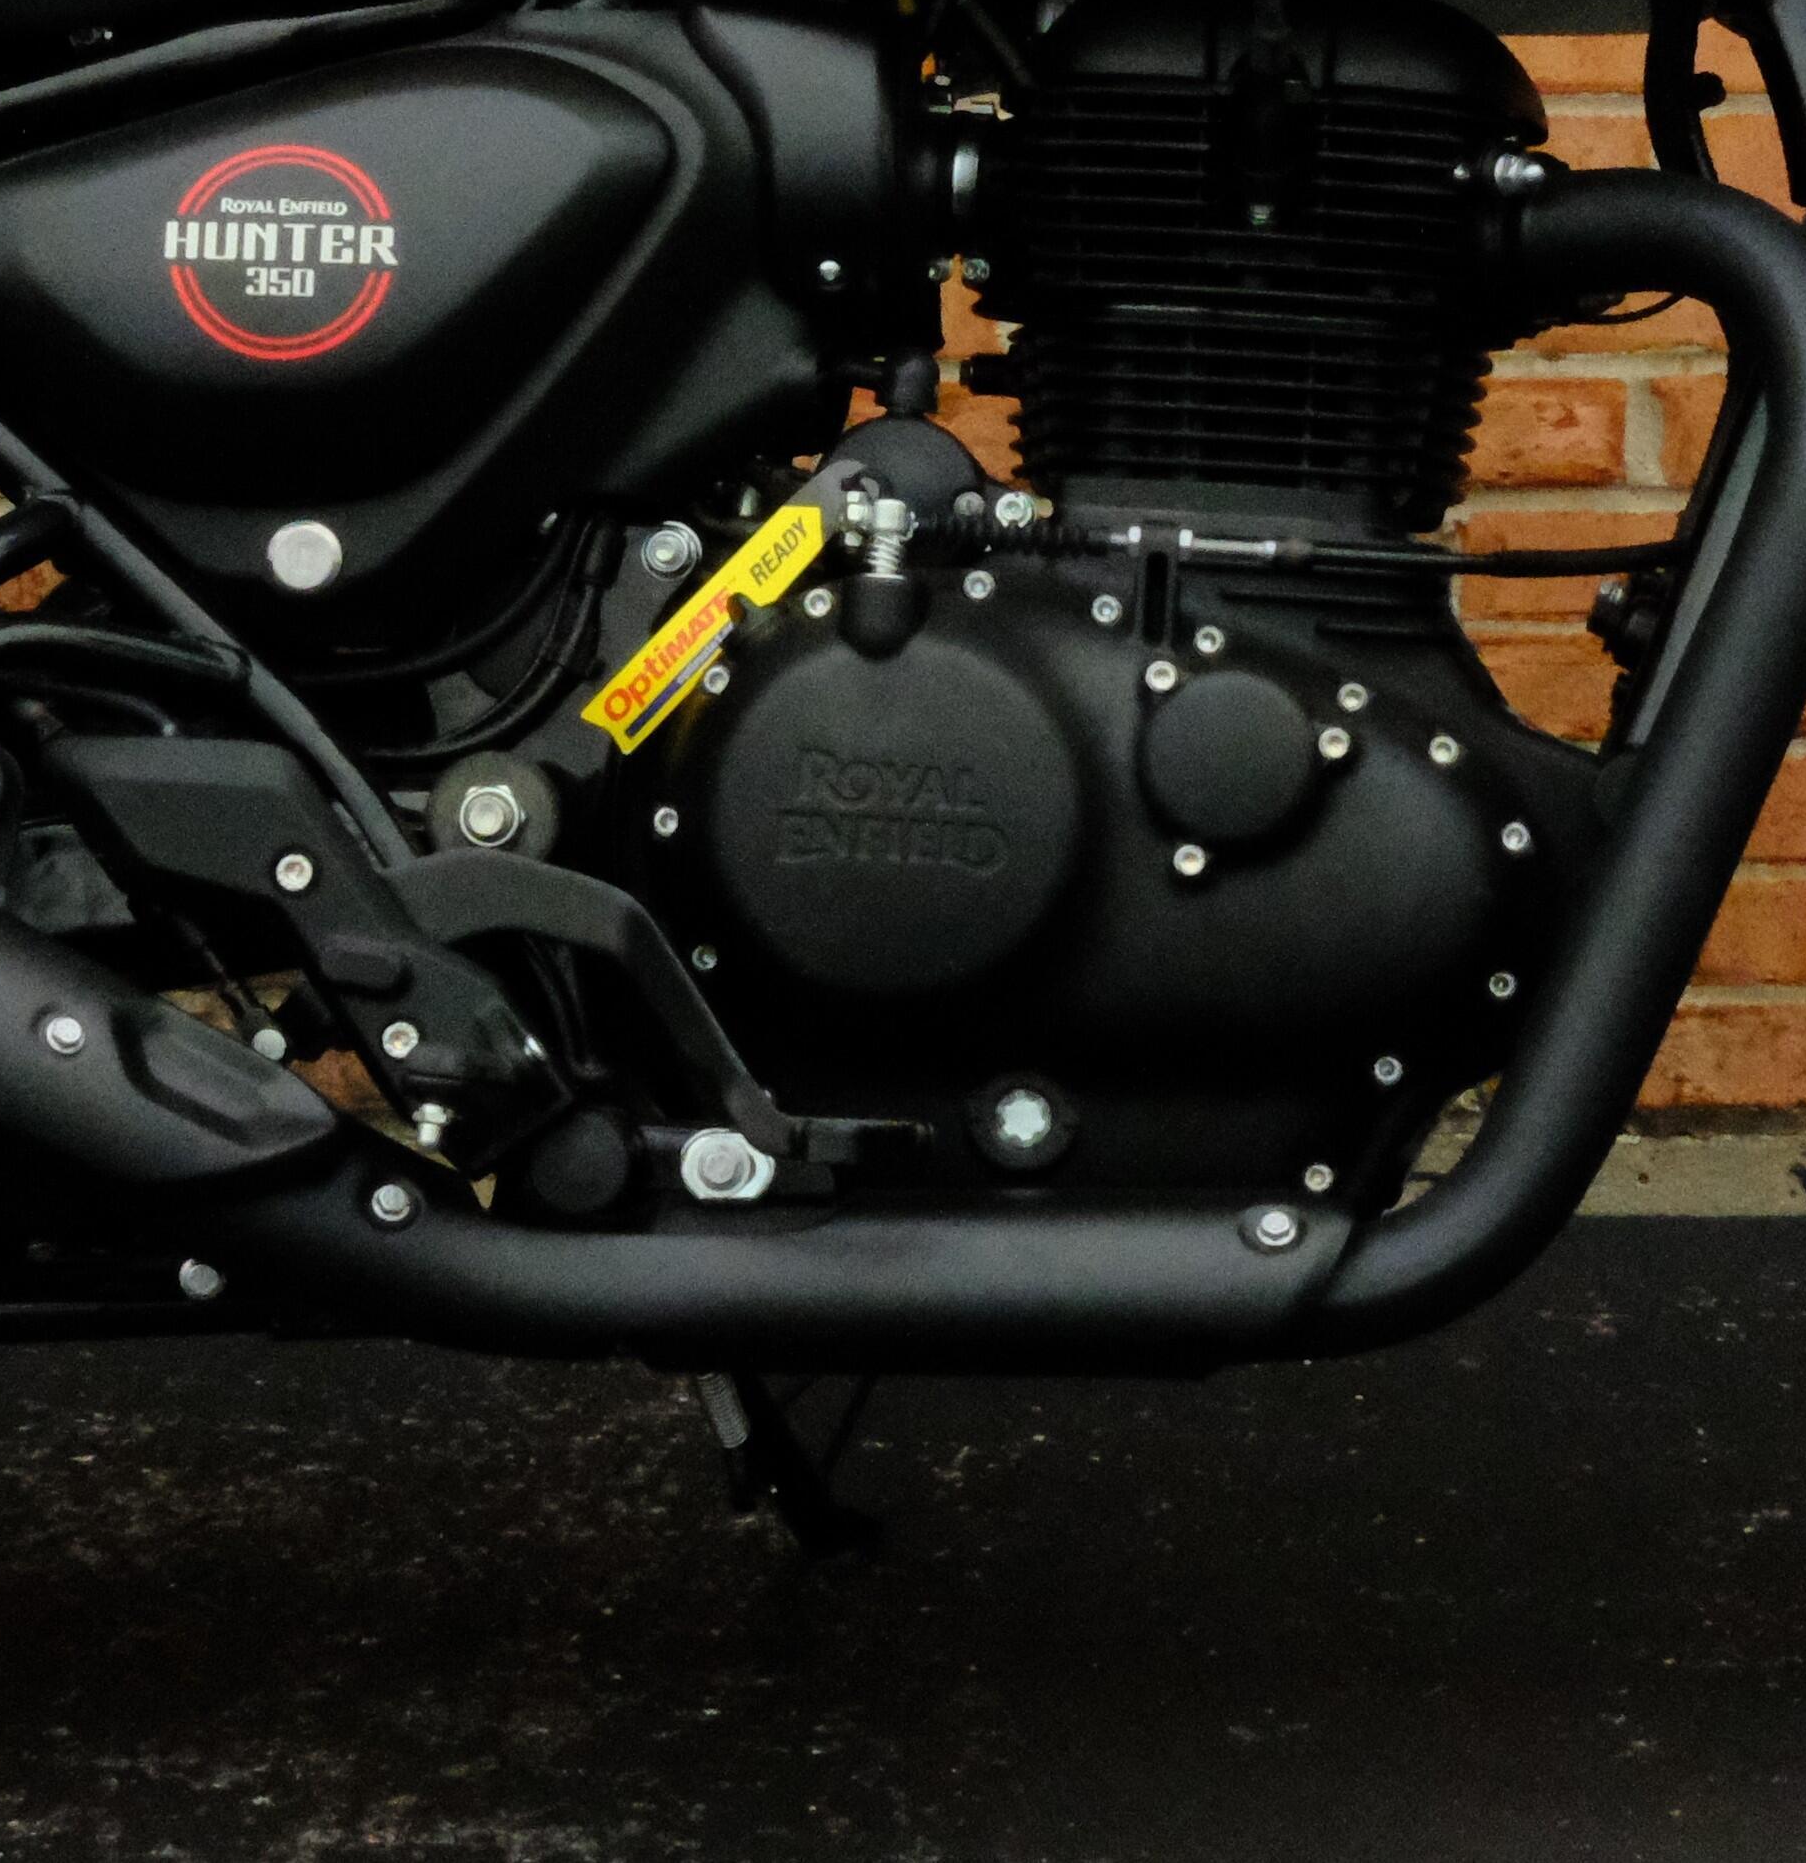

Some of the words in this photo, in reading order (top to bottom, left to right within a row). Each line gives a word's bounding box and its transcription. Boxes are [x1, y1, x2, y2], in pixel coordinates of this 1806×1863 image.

[220, 197, 276, 215] ROYAL
[278, 197, 348, 217] ENFIELD
[164, 220, 399, 266] HUNTER
[245, 266, 315, 298] 350
[748, 515, 809, 587] READY
[793, 743, 987, 809] ROYAL
